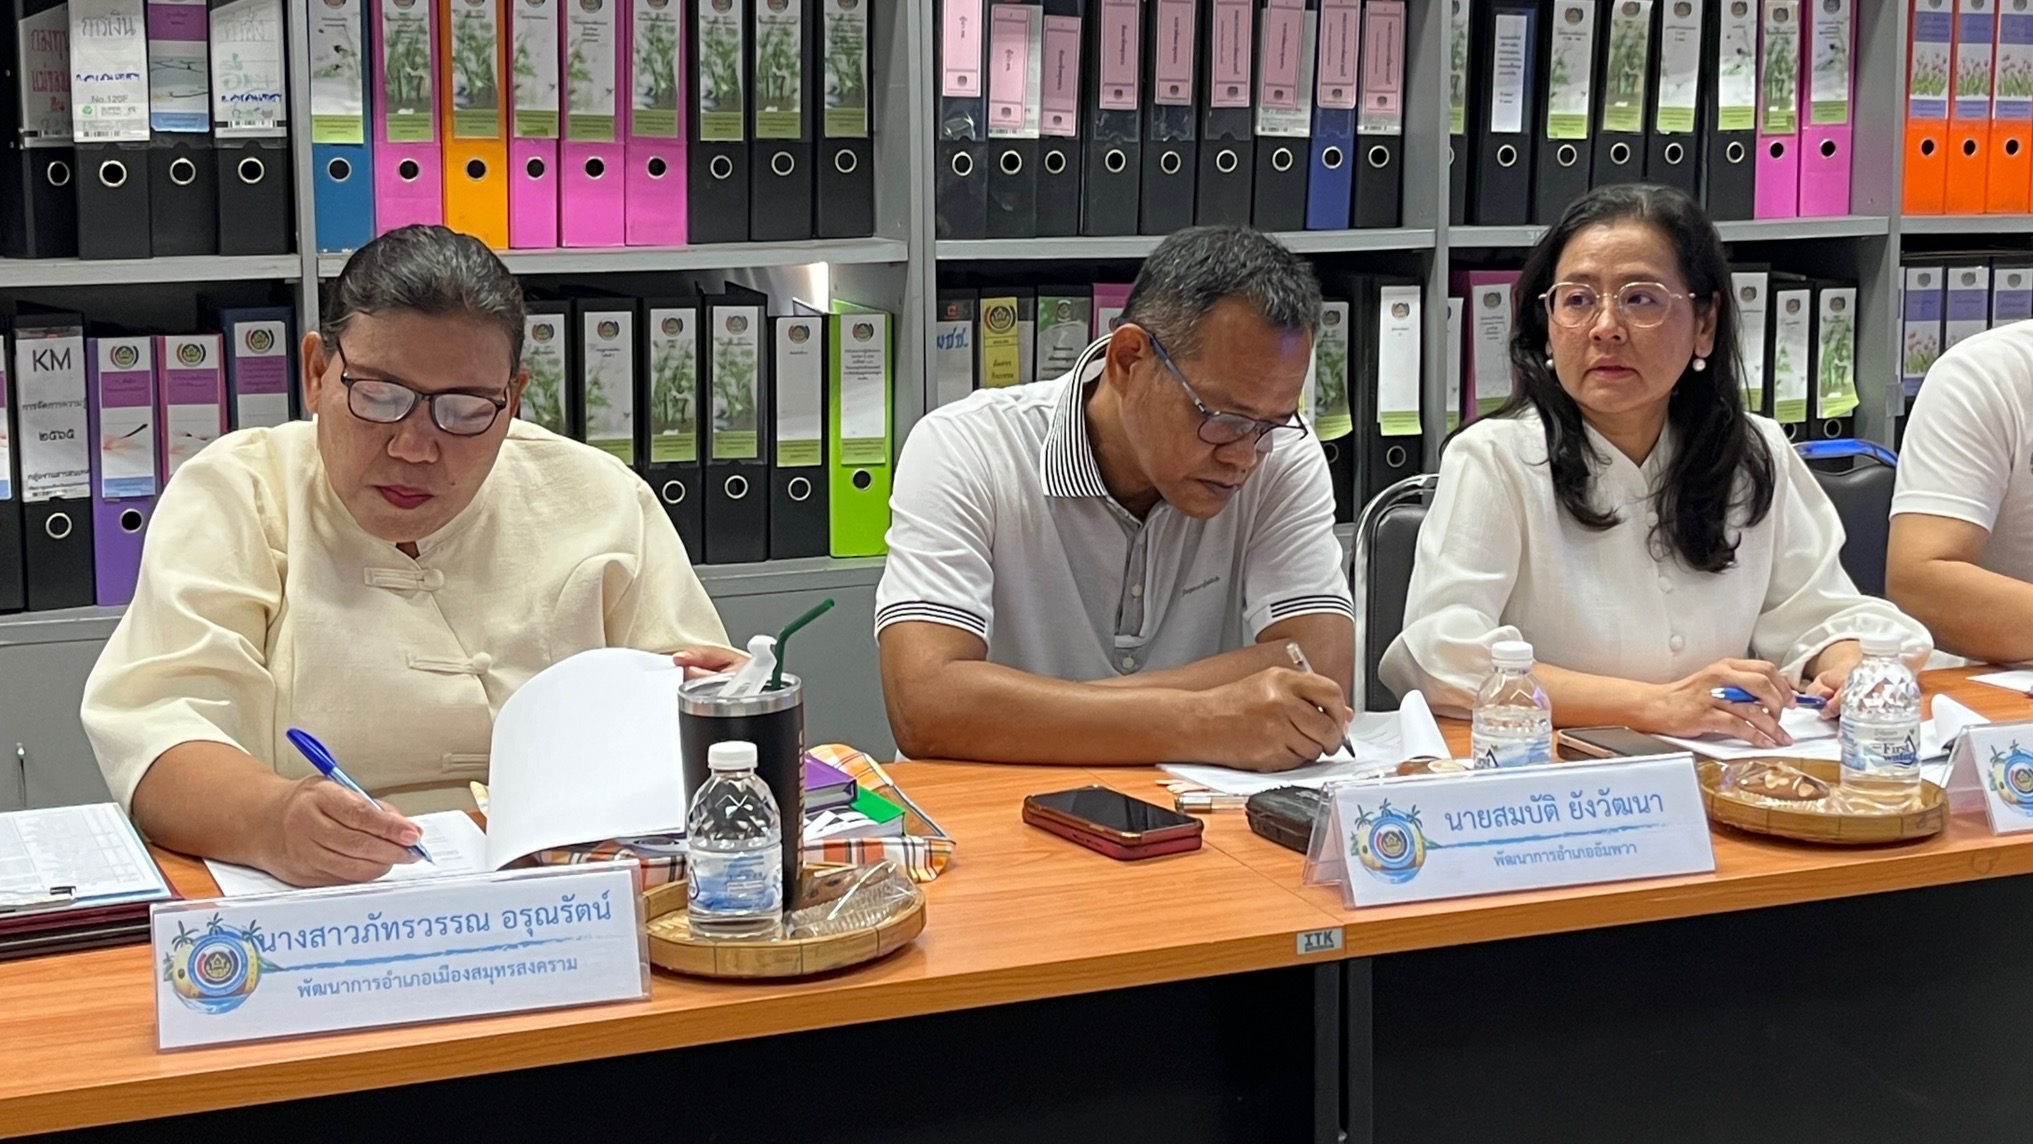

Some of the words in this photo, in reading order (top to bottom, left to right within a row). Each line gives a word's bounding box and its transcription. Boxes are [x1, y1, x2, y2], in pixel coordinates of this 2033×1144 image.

[32, 346, 72, 373] KM
[1444, 793, 1560, 832] นายสมบัติ
[1568, 787, 1665, 821] ยังวัฒนา
[1493, 841, 1638, 867] พัฒนาการอำเภออัมพวา
[257, 911, 490, 953] นางสาวภัทรวรรณ
[501, 889, 612, 938] อรุณรัตน์
[1304, 930, 1334, 946] ITK
[297, 957, 578, 998] พัฒนาการอำเภอเมืองสมุทรสงคราม
